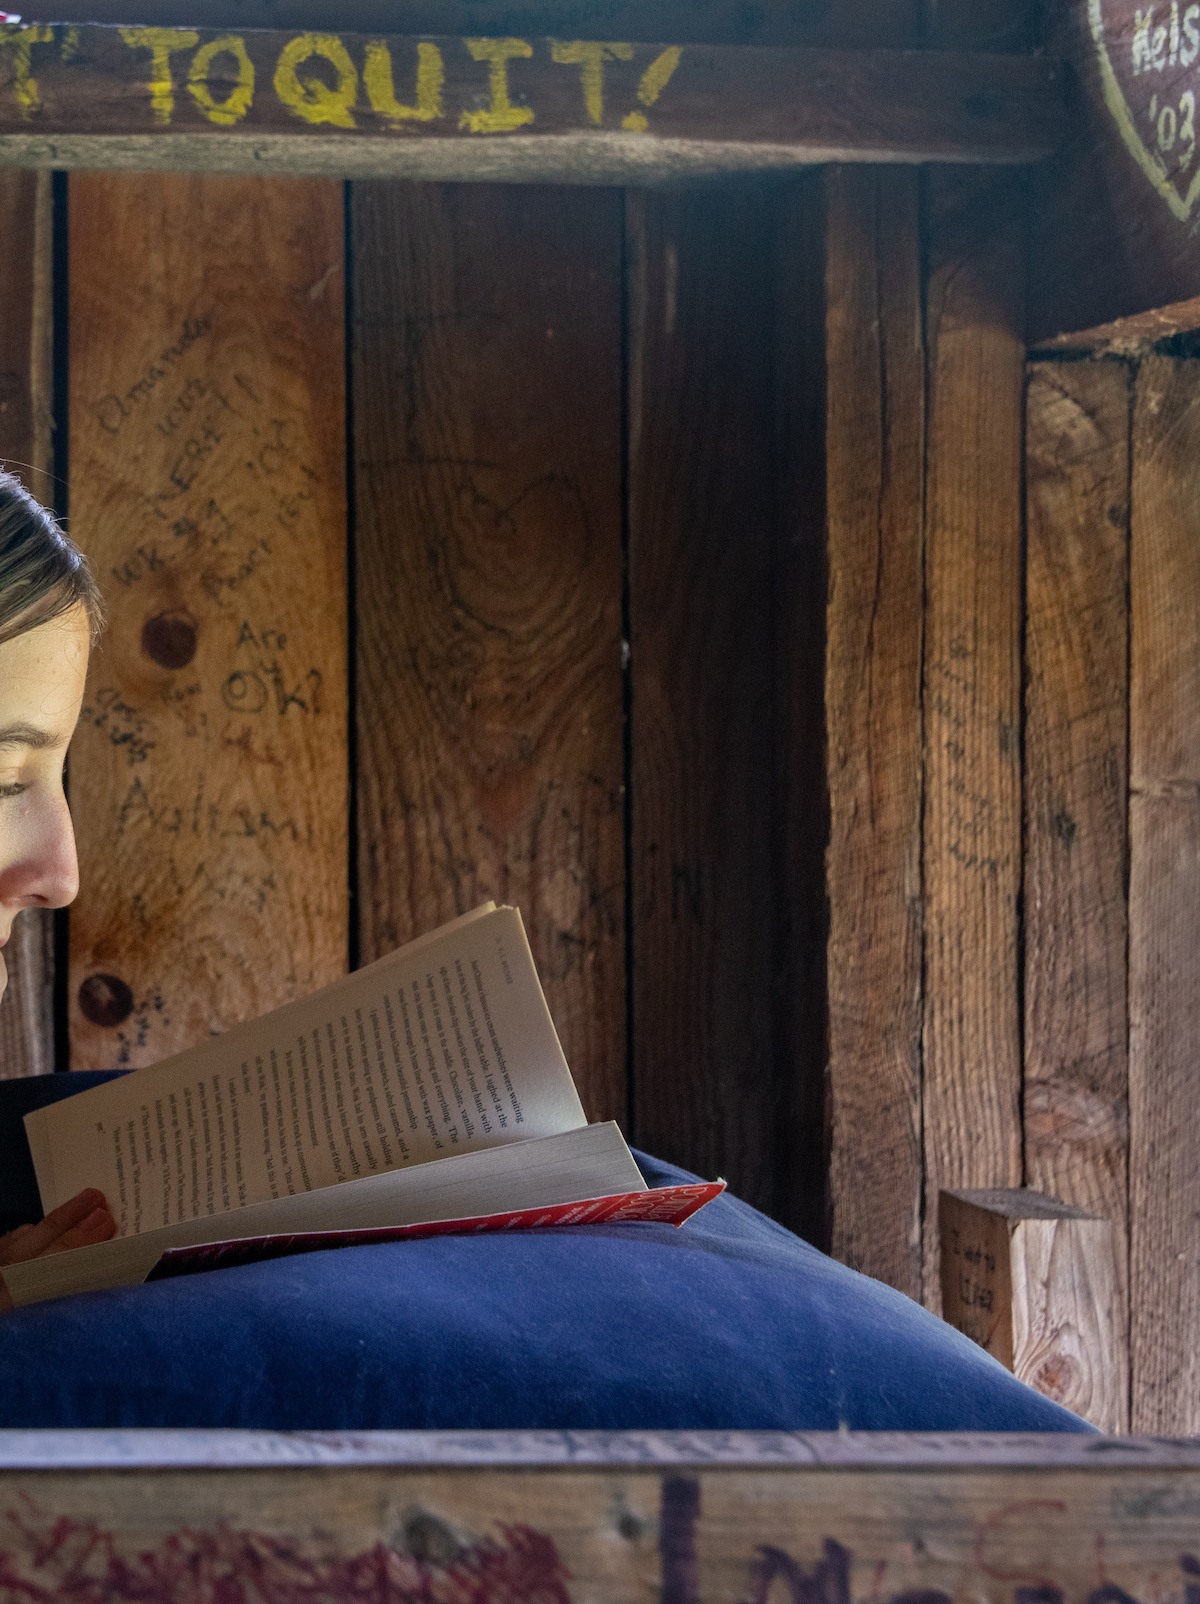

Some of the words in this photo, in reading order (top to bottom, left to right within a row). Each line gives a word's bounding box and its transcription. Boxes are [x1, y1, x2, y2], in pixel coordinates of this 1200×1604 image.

[118, 27, 255, 126] TO
[273, 32, 682, 133] QUIT!
[464, 1067, 475, 1077] of
[477, 1053, 492, 1074] table.
[416, 1083, 429, 1100] with
[466, 1075, 478, 1094] your
[483, 1076, 502, 1104] sighed
[501, 1072, 514, 1092] were
[399, 1089, 421, 1133] penmanship.
[420, 1098, 431, 1115] wax
[447, 1069, 467, 1108] Chocolate,
[458, 1107, 477, 1139] vanilla,
[472, 1092, 487, 1114] hand
[493, 1103, 503, 1113] at
[506, 1090, 527, 1124] waiting
[356, 1113, 366, 1125] his
[388, 1106, 404, 1137] caramel,
[432, 1083, 454, 1126] everything.
[446, 1124, 461, 1145] The
[478, 1112, 494, 1134] with
[496, 1112, 510, 1129] the
[358, 1124, 368, 1139] arm
[374, 1120, 386, 1135] still
[423, 1114, 439, 1140] paper,
[328, 1140, 336, 1152] see
[377, 1134, 395, 1167] holding
[396, 1136, 409, 1154] and
[433, 1138, 444, 1150] of
[330, 1150, 339, 1158] if
[361, 1138, 378, 1171] casually
[401, 1153, 410, 1161] a
[267, 1169, 276, 1183] this
[283, 1165, 293, 1184] "You
[296, 1150, 312, 1192] conversation
[331, 1156, 345, 1182] they'd
[269, 1182, 276, 1190] is
